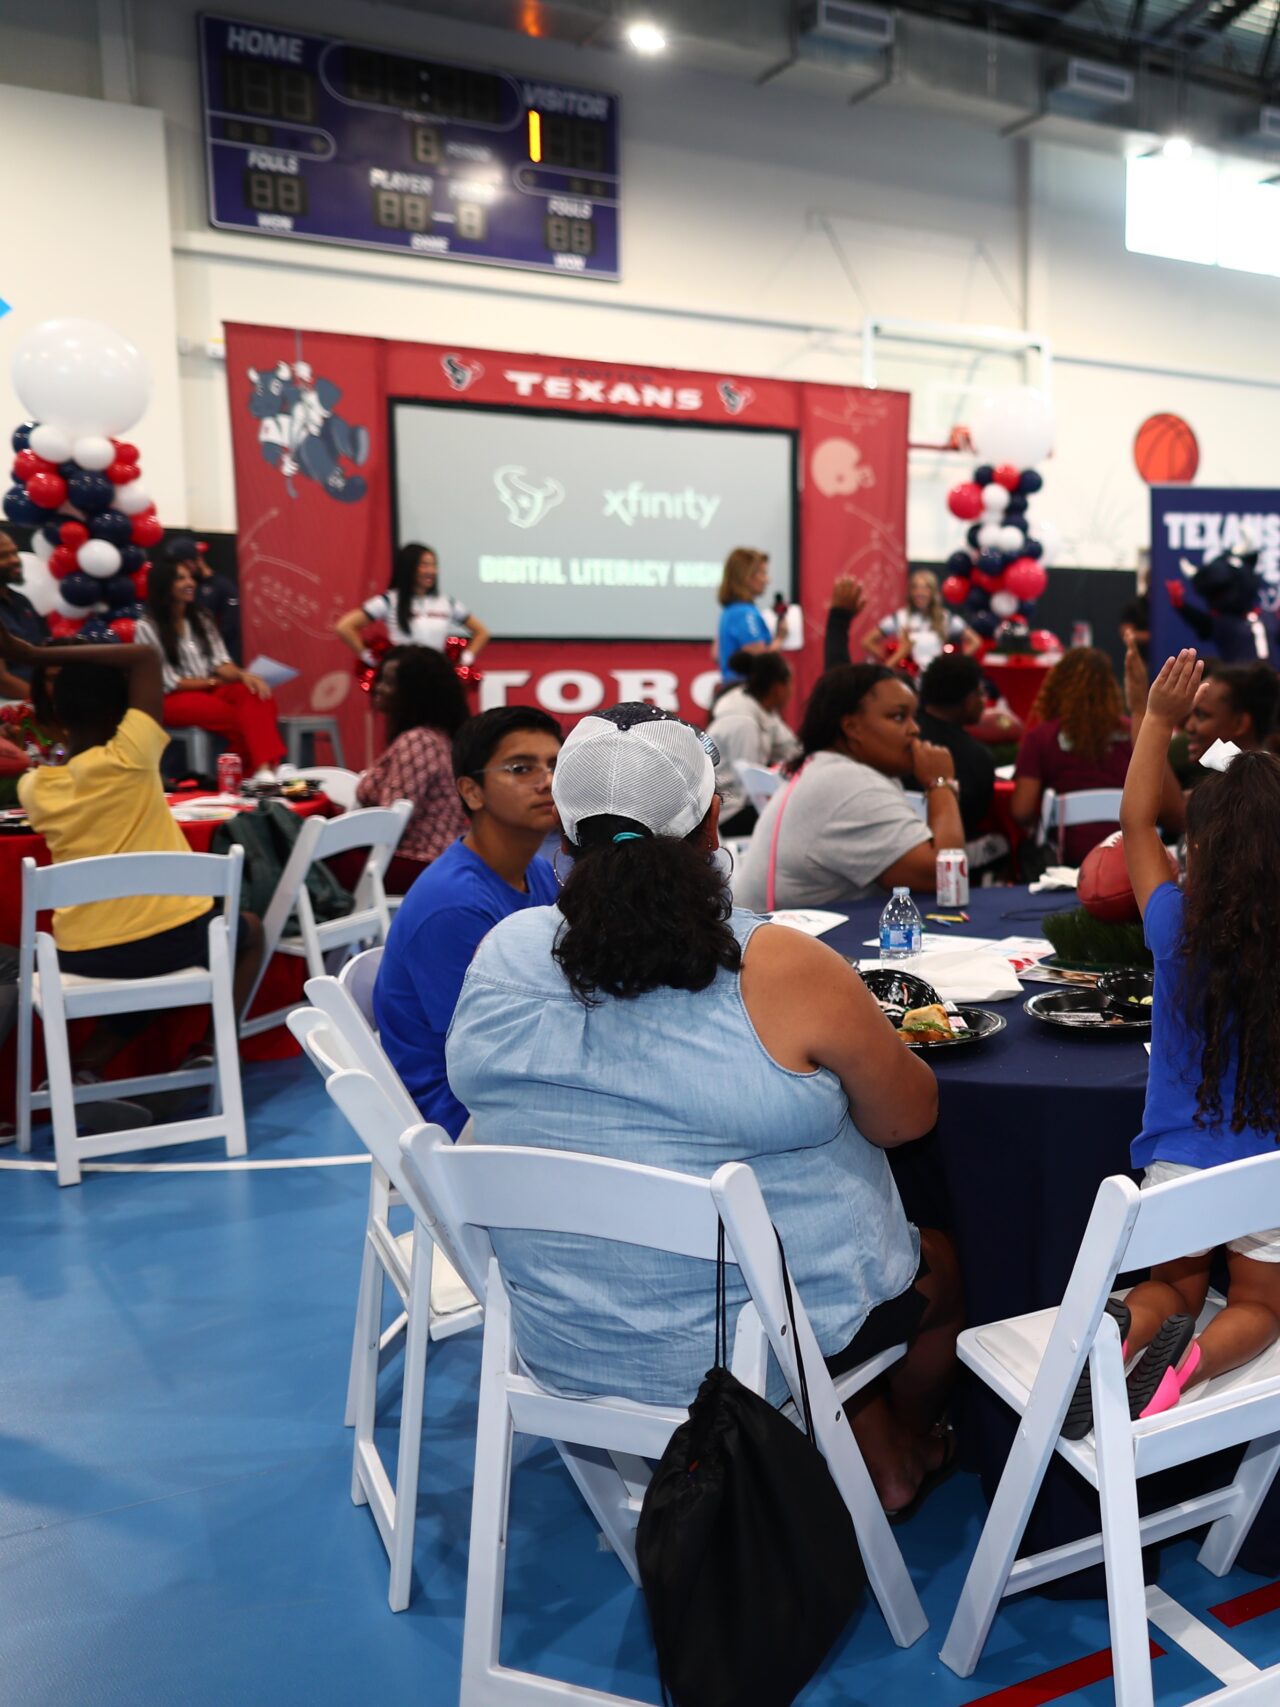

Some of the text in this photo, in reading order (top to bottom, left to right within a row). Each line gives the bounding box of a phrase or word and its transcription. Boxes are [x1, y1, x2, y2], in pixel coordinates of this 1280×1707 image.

[227, 26, 303, 63] HOME
[248, 151, 299, 174] FOULS
[369, 168, 433, 195] PLAYER
[503, 369, 703, 411] TEXANS
[602, 480, 721, 529] xfinity
[478, 555, 567, 584] DIGITAL
[569, 558, 671, 587] LITERACY
